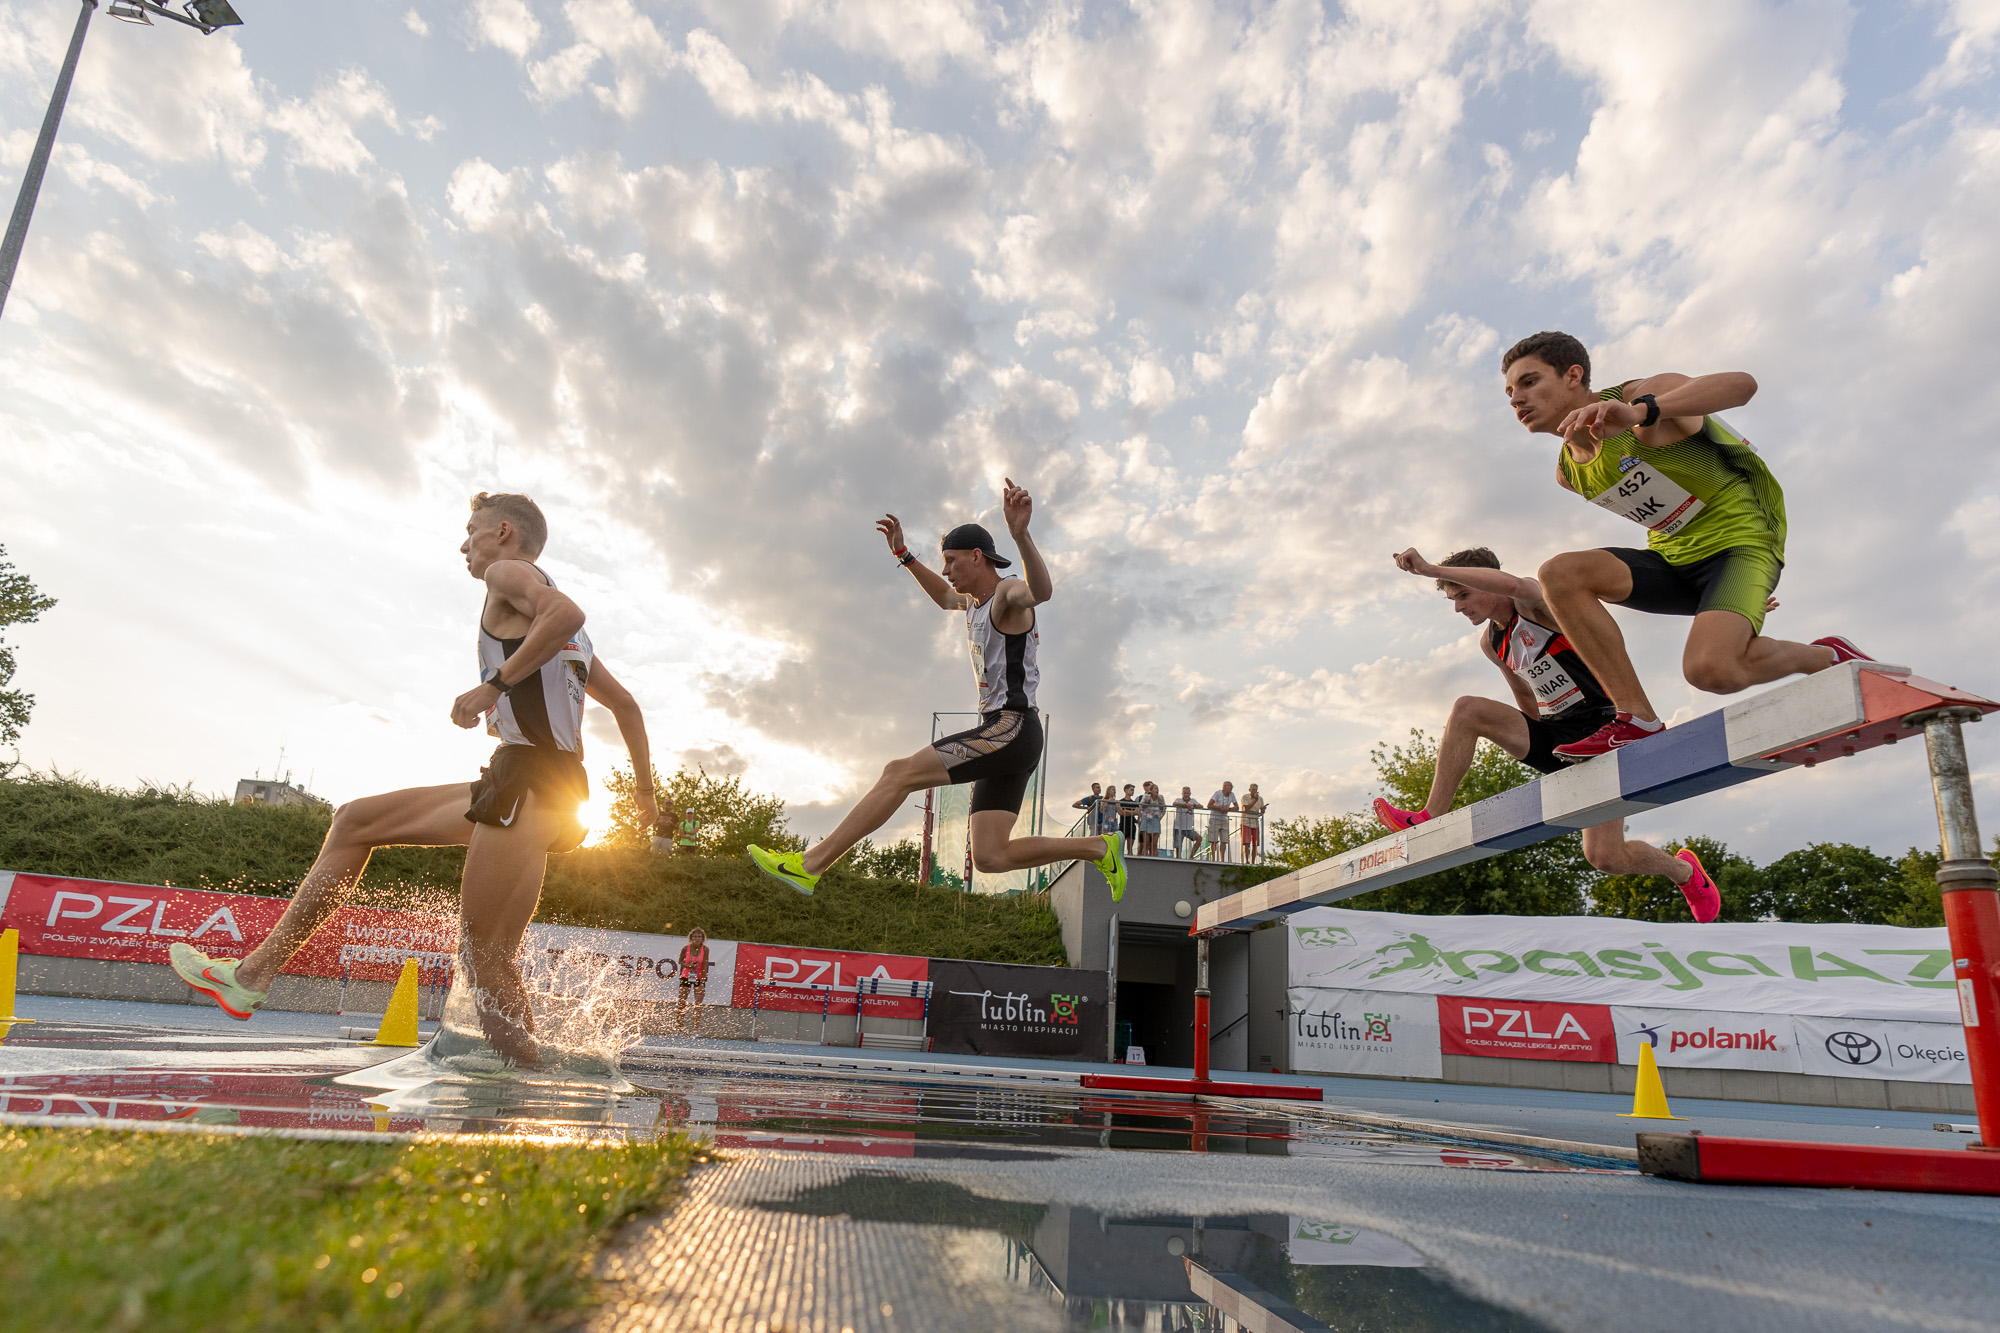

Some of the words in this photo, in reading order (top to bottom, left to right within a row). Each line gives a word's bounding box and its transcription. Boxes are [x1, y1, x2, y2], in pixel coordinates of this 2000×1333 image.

[1618, 457, 1641, 473] MKS
[1618, 471, 1652, 498] 452
[1665, 519, 1683, 533] 2023
[1527, 660, 1552, 679] 333
[45, 890, 244, 942] PZLA
[42, 933, 87, 943] POLSKI
[89, 936, 143, 948] ZWIĄZEK
[762, 991, 792, 999] POLSKI
[831, 996, 858, 1004] LEKKIE
[863, 999, 899, 1007] ATLETYKI
[981, 1023, 1018, 1032] MIASTO
[1023, 1026, 1079, 1036] INSPIRACJI
[1462, 1006, 1591, 1041] PZLA
[1298, 1041, 1334, 1049] MIASTO
[1339, 1044, 1393, 1053] INSPIRACJI
[1493, 1040, 1527, 1049] ZWIĄZEK
[1528, 1042, 1557, 1050] LEKKIEJ
[1132, 1053, 1141, 1061] 17
[1897, 1043, 1965, 1064] Okęcie
